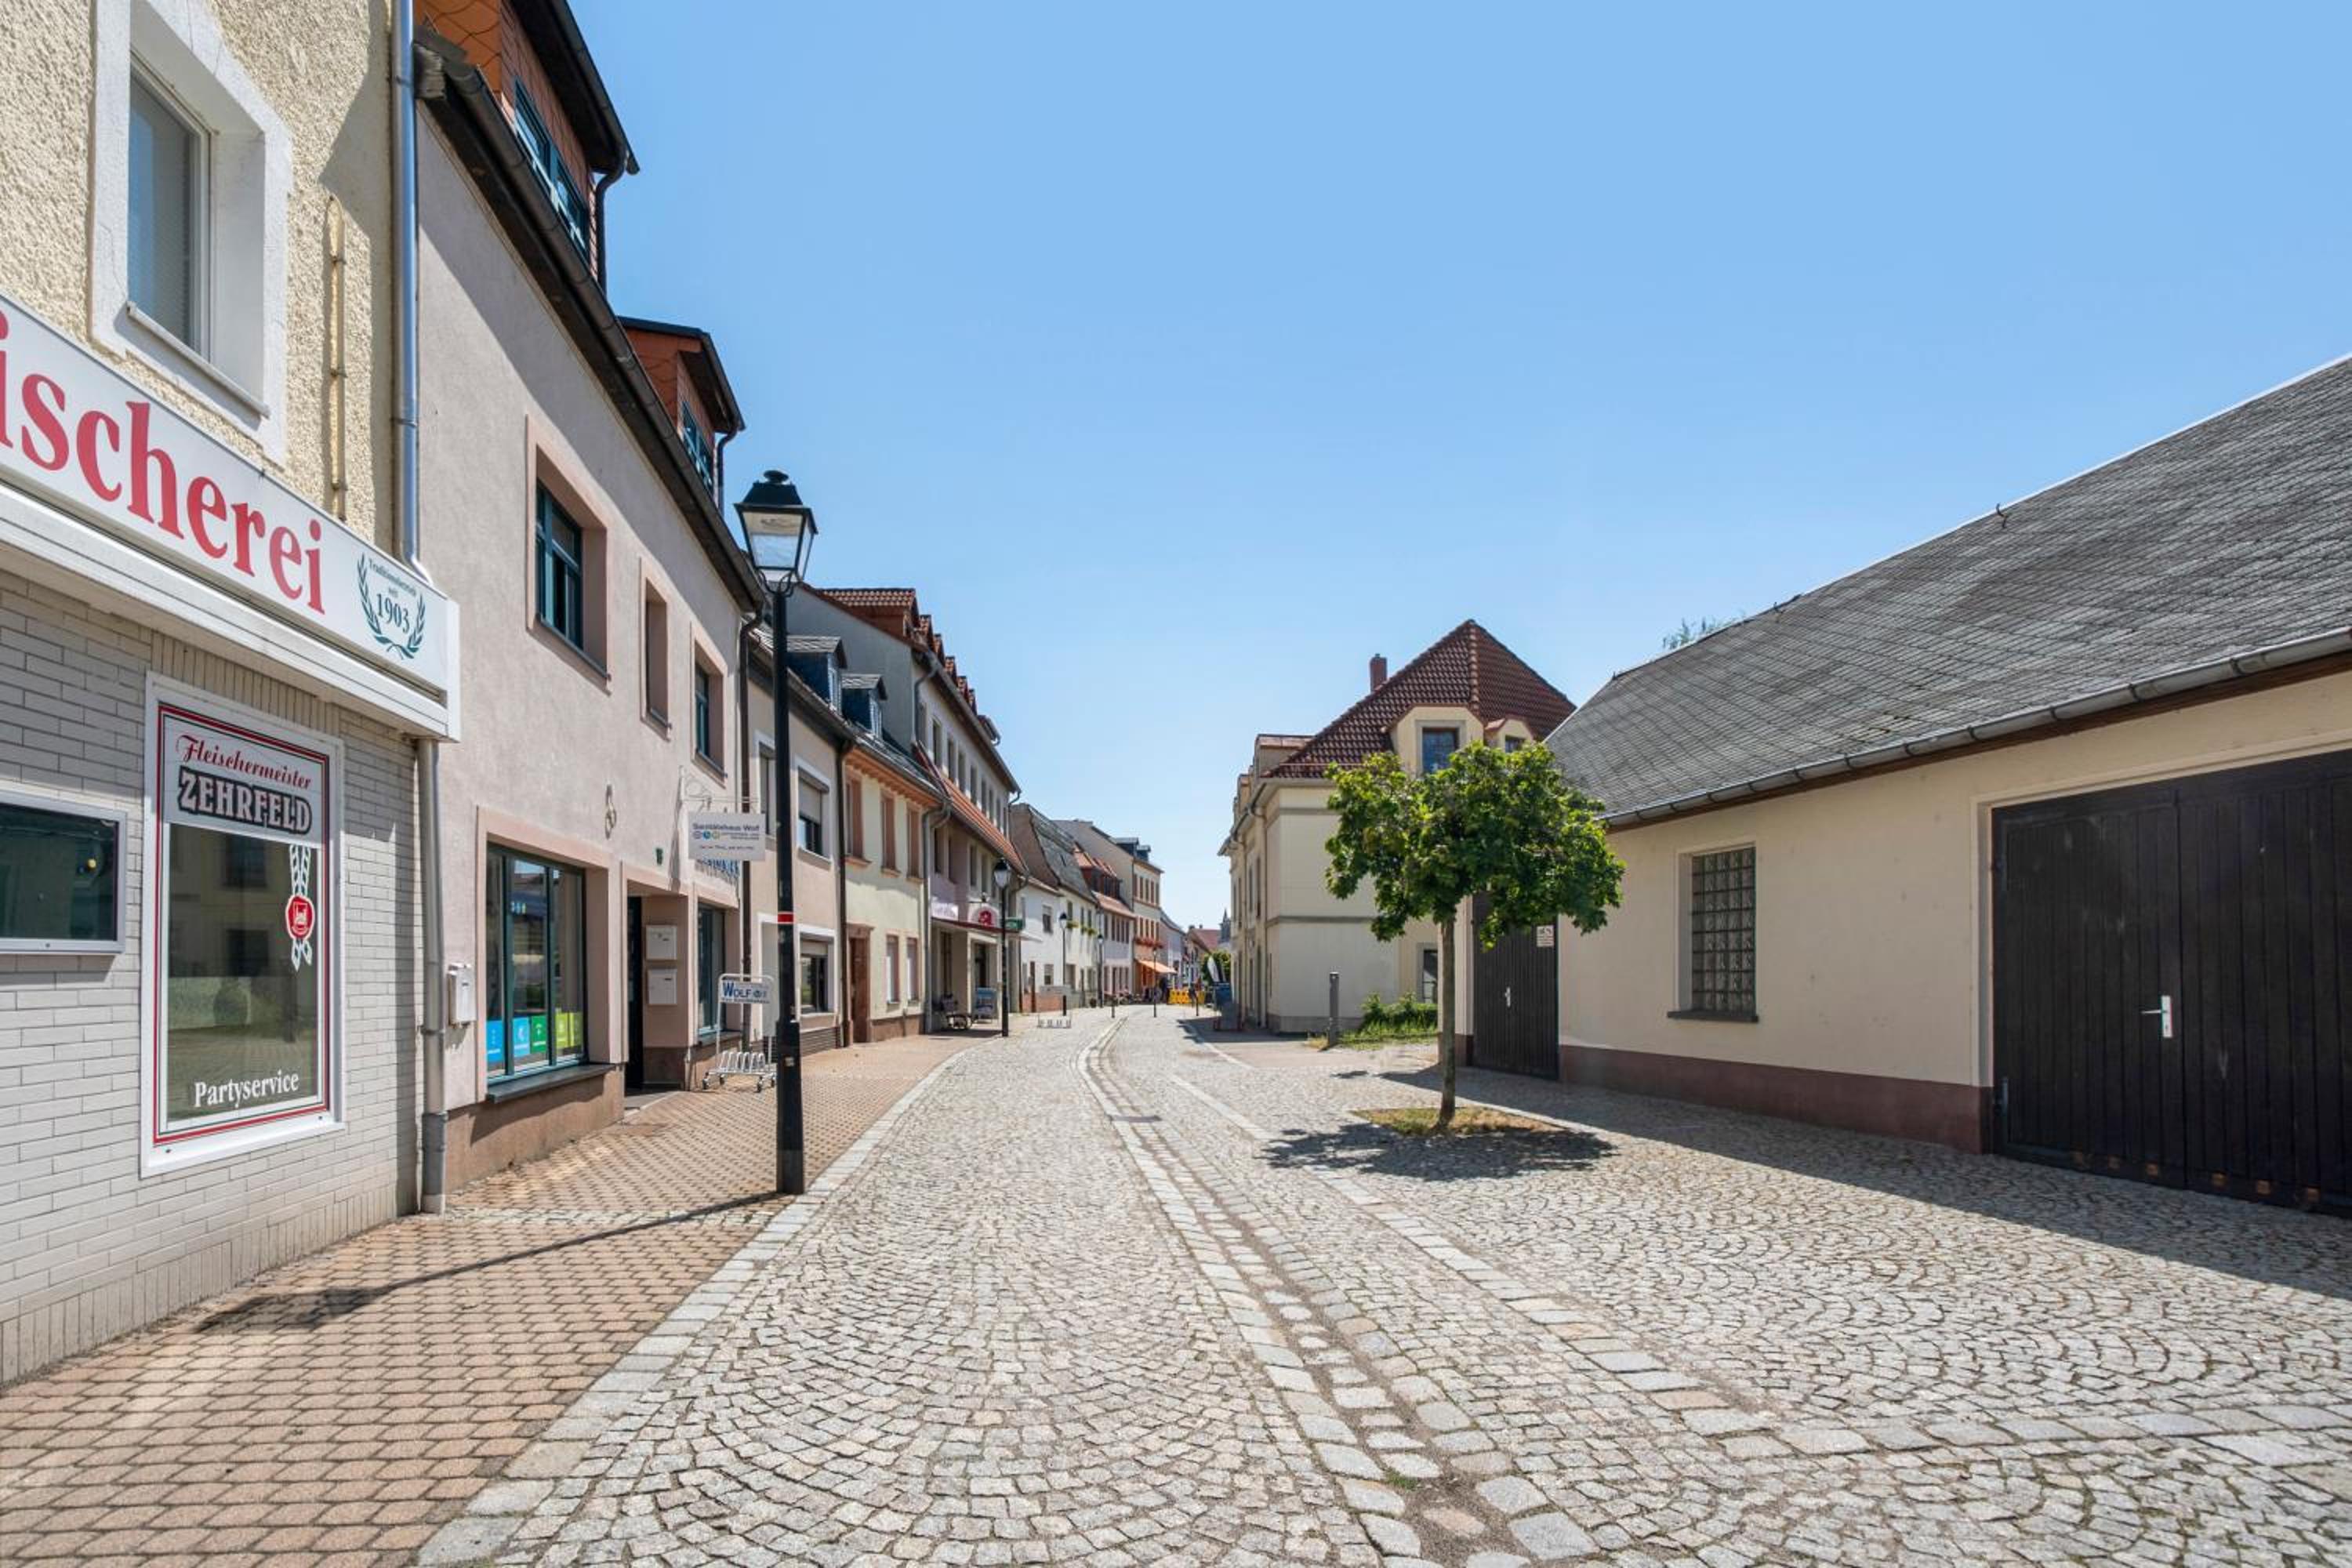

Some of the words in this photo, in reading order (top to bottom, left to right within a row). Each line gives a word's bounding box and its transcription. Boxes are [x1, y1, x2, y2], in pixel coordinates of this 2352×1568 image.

[376, 593, 410, 633] 1903
[176, 735, 311, 789] Fleischermeister
[178, 766, 312, 835] ZEHRFELD
[194, 1069, 299, 1108] Partyservice
